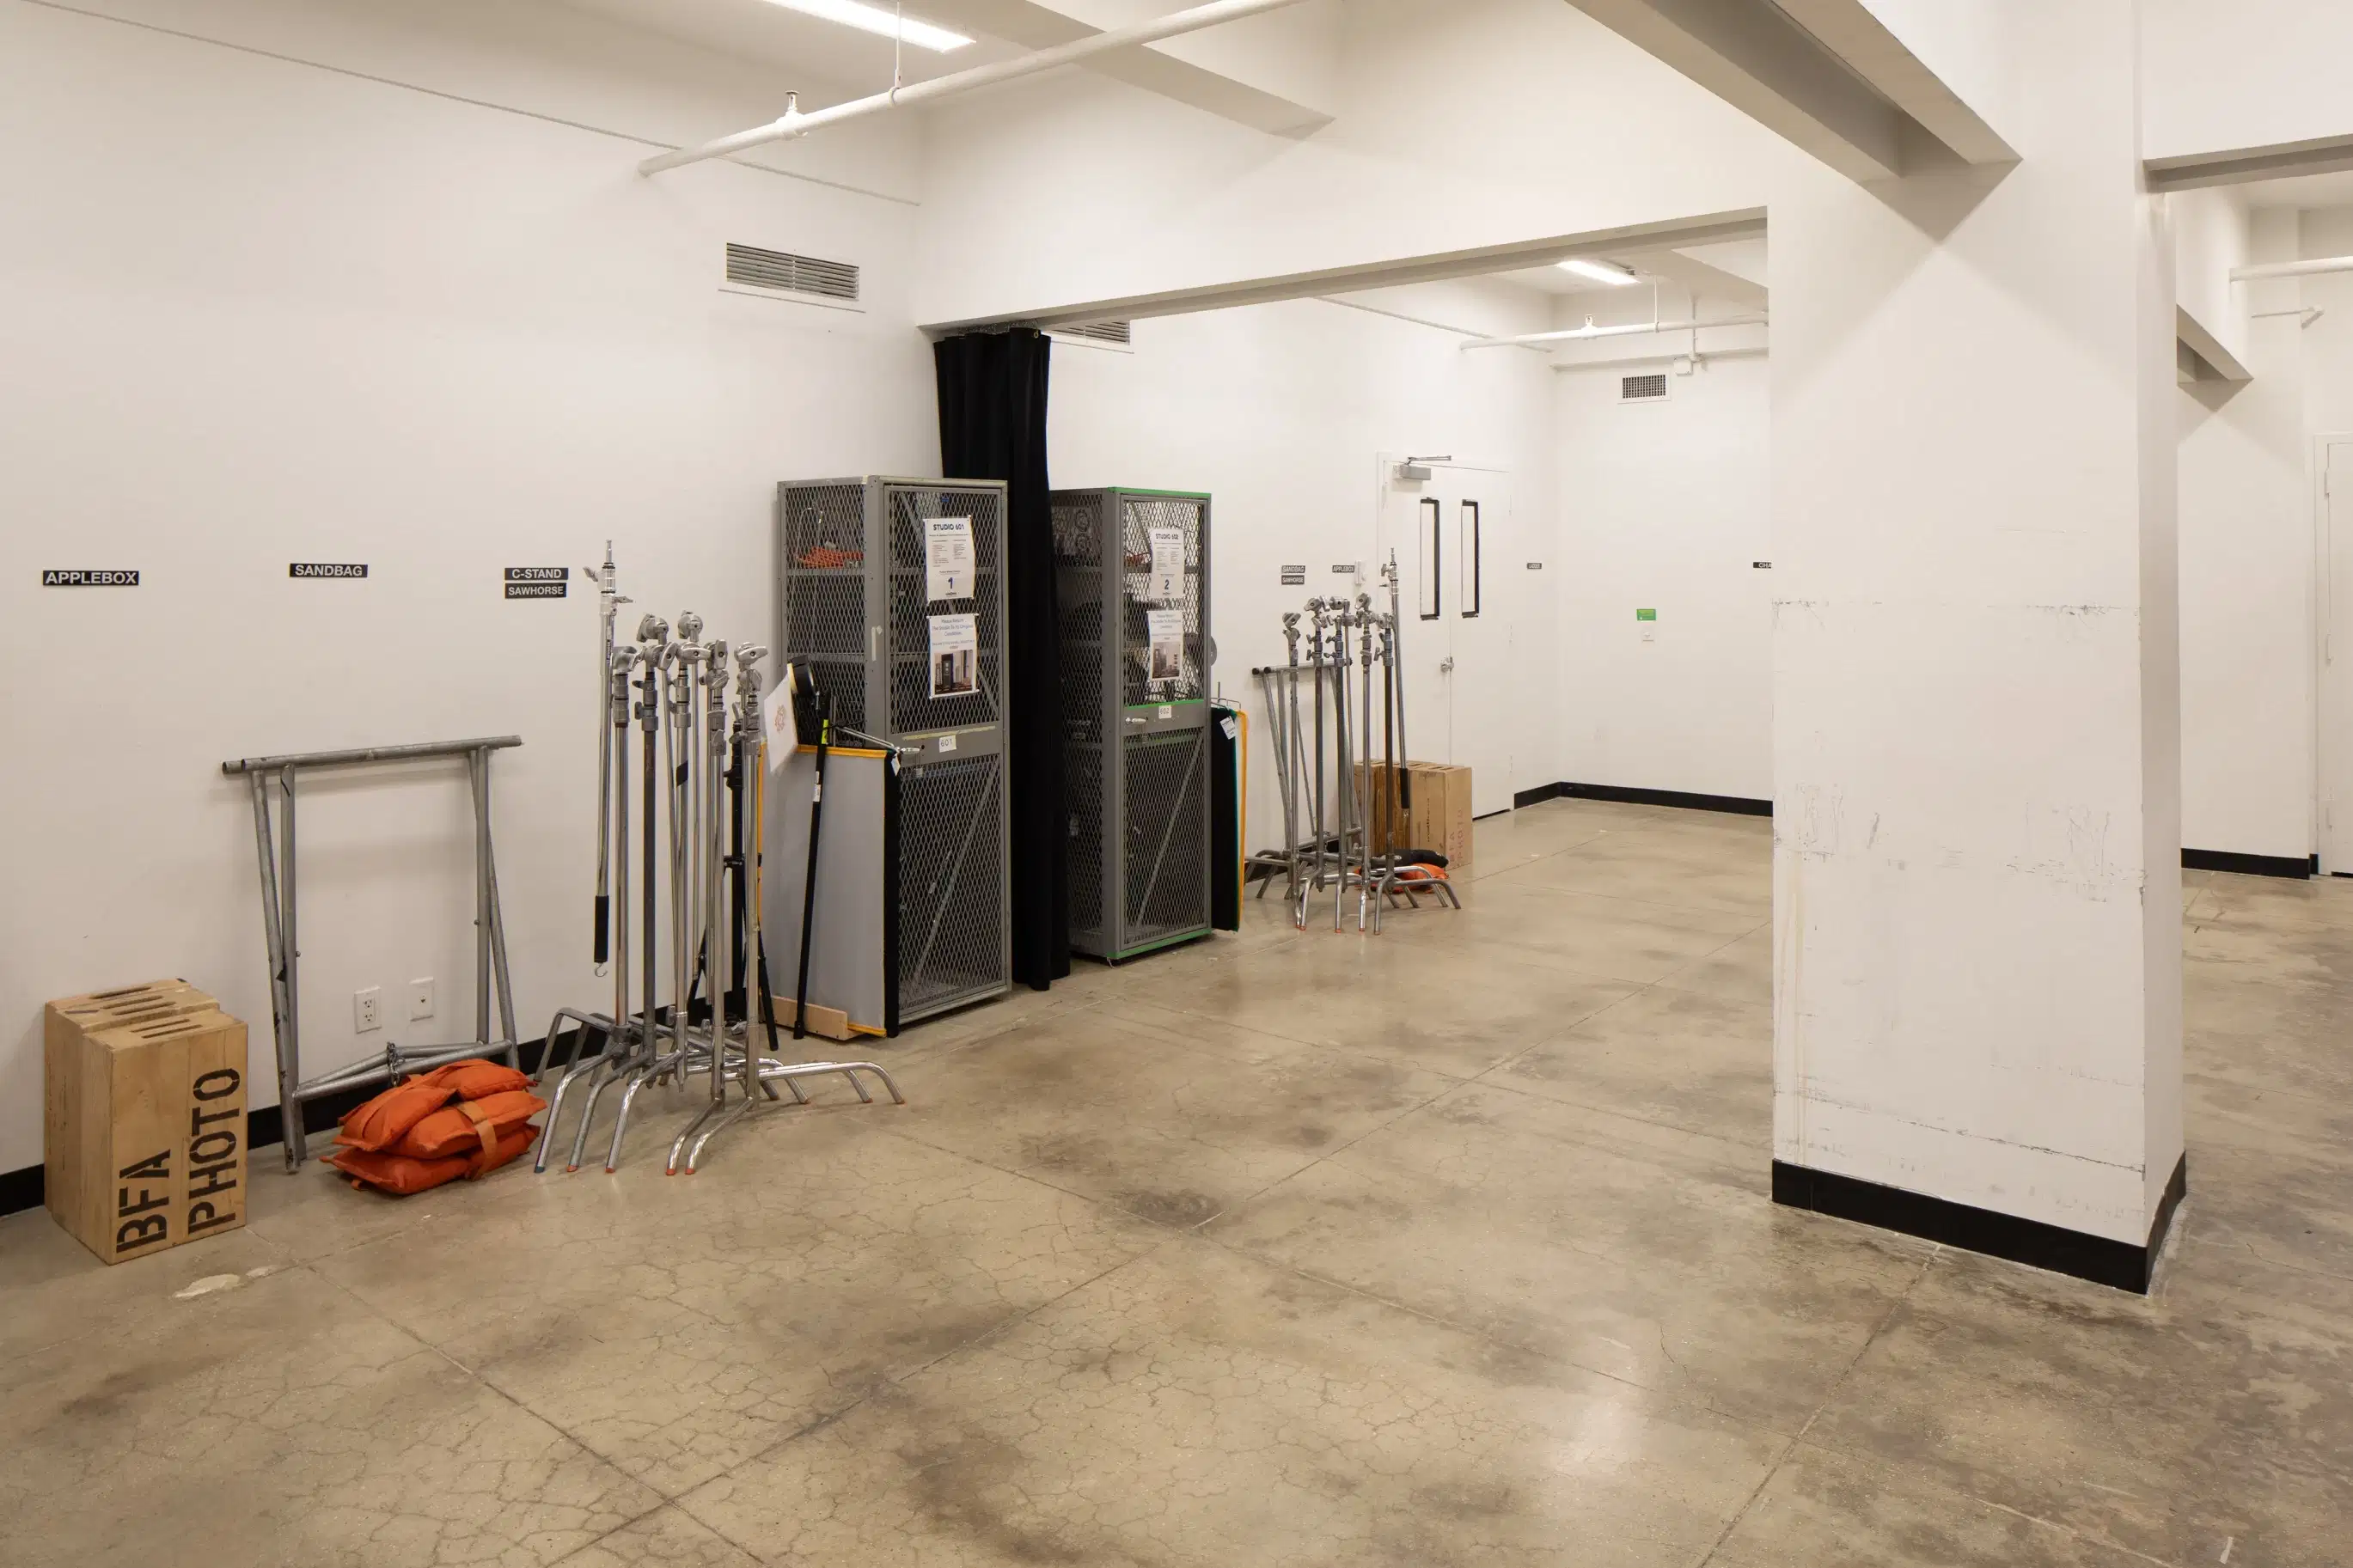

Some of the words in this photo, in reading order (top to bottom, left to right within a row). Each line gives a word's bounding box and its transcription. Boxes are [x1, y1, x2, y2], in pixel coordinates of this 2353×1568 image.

[295, 564, 363, 577] SANDBAG
[511, 568, 562, 579] C-STAND
[45, 571, 138, 584] APPLEBOX
[948, 577, 953, 589] 1
[508, 586, 564, 595] SAWHORSE
[1164, 579, 1170, 590] 2
[940, 738, 952, 747] 601
[187, 1068, 241, 1235] PHOTO
[116, 1149, 171, 1254] BFA
